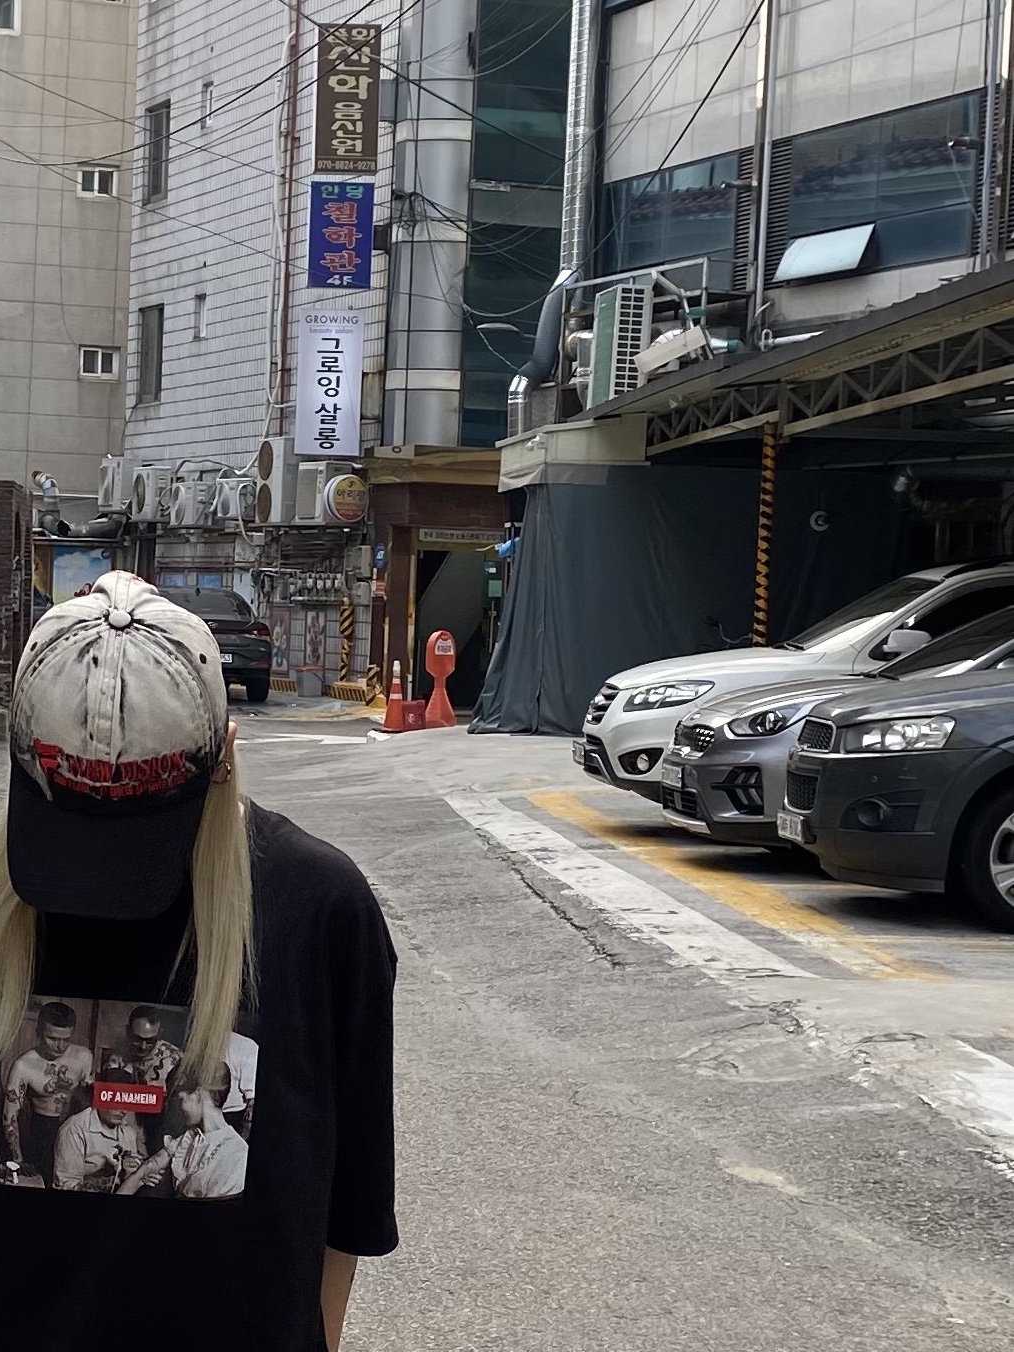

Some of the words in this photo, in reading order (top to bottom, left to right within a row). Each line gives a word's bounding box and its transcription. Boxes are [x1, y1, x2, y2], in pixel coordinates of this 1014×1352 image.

[326, 274, 353, 286] 4F
[305, 314, 359, 325] GROWING
[316, 337, 344, 397] 그로잉
[313, 403, 342, 449] 살롱
[100, 1090, 114, 1102] OF
[114, 1091, 157, 1105] ANAHEIM
